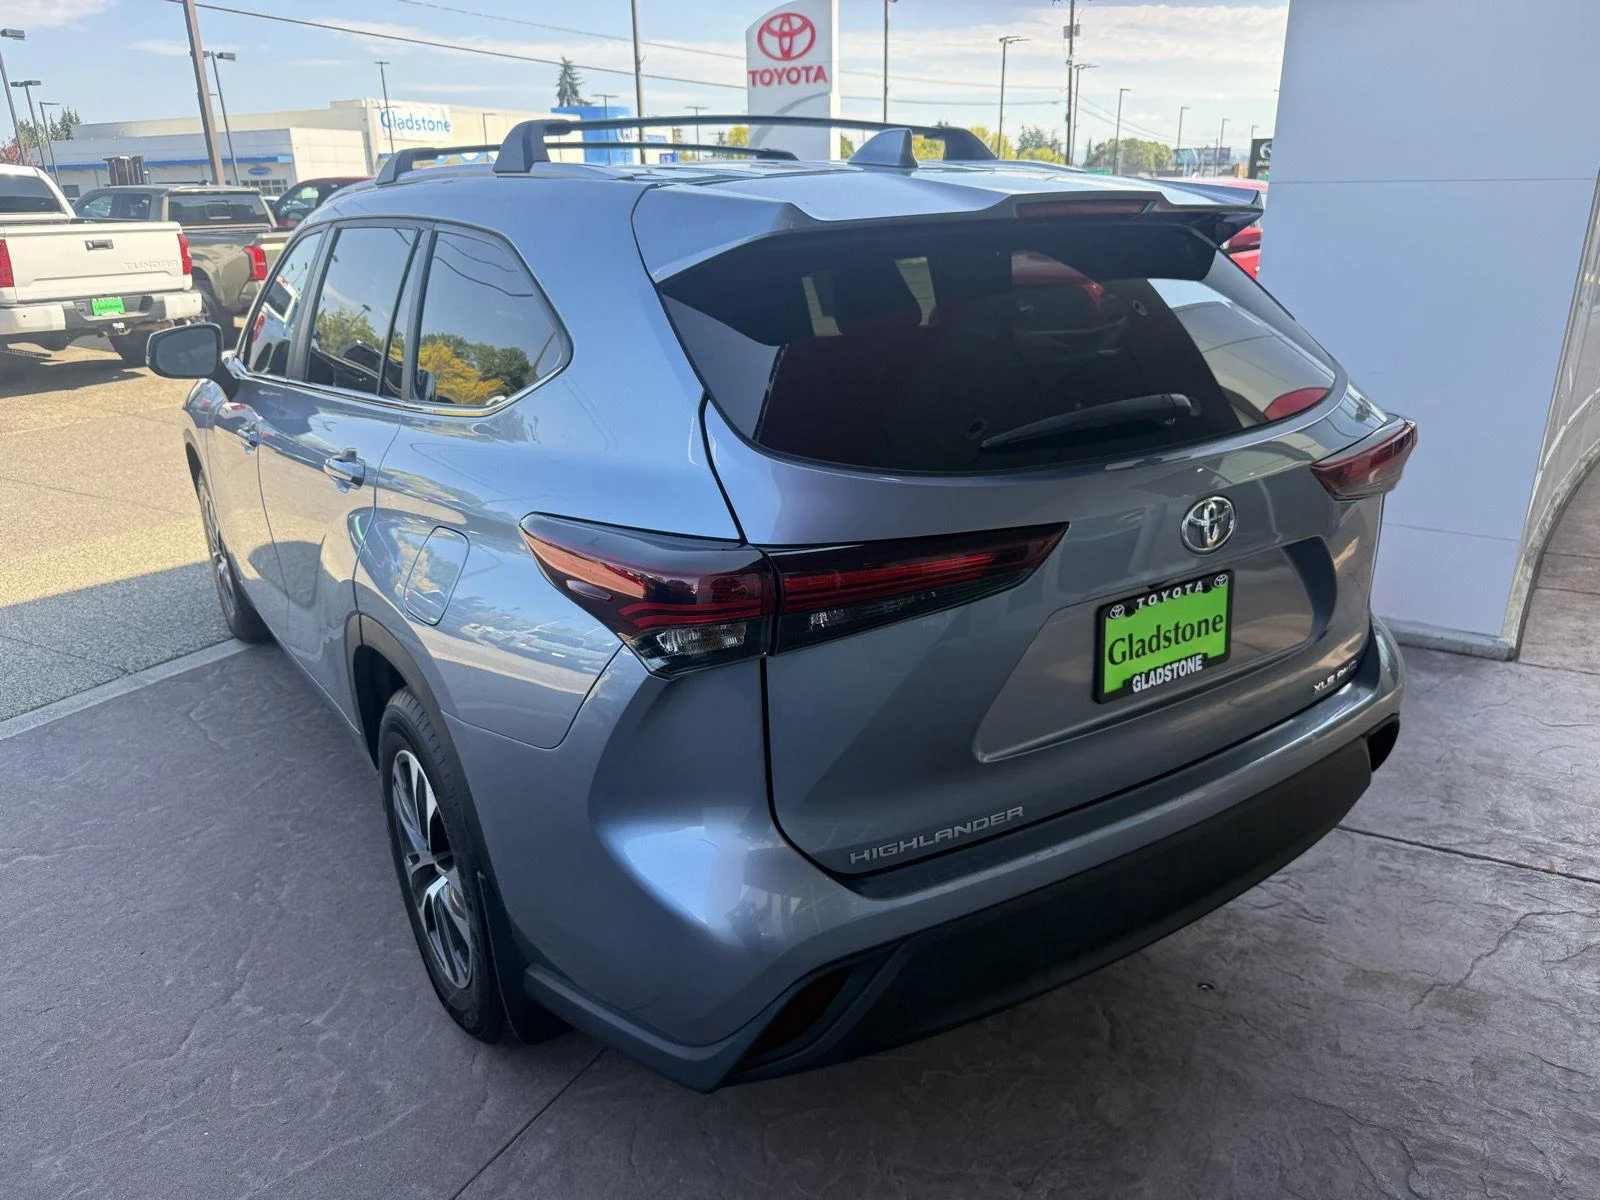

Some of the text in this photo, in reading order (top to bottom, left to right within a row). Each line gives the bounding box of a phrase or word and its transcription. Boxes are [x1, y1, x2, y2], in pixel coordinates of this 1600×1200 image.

[748, 64, 828, 88] TOYOTA
[380, 111, 451, 132] Gladstone
[1136, 581, 1204, 609] TOYOTA
[1107, 614, 1224, 666] Gladstone
[1132, 654, 1203, 692] GLADSTONE
[850, 806, 1024, 864] HIGHLANDER
